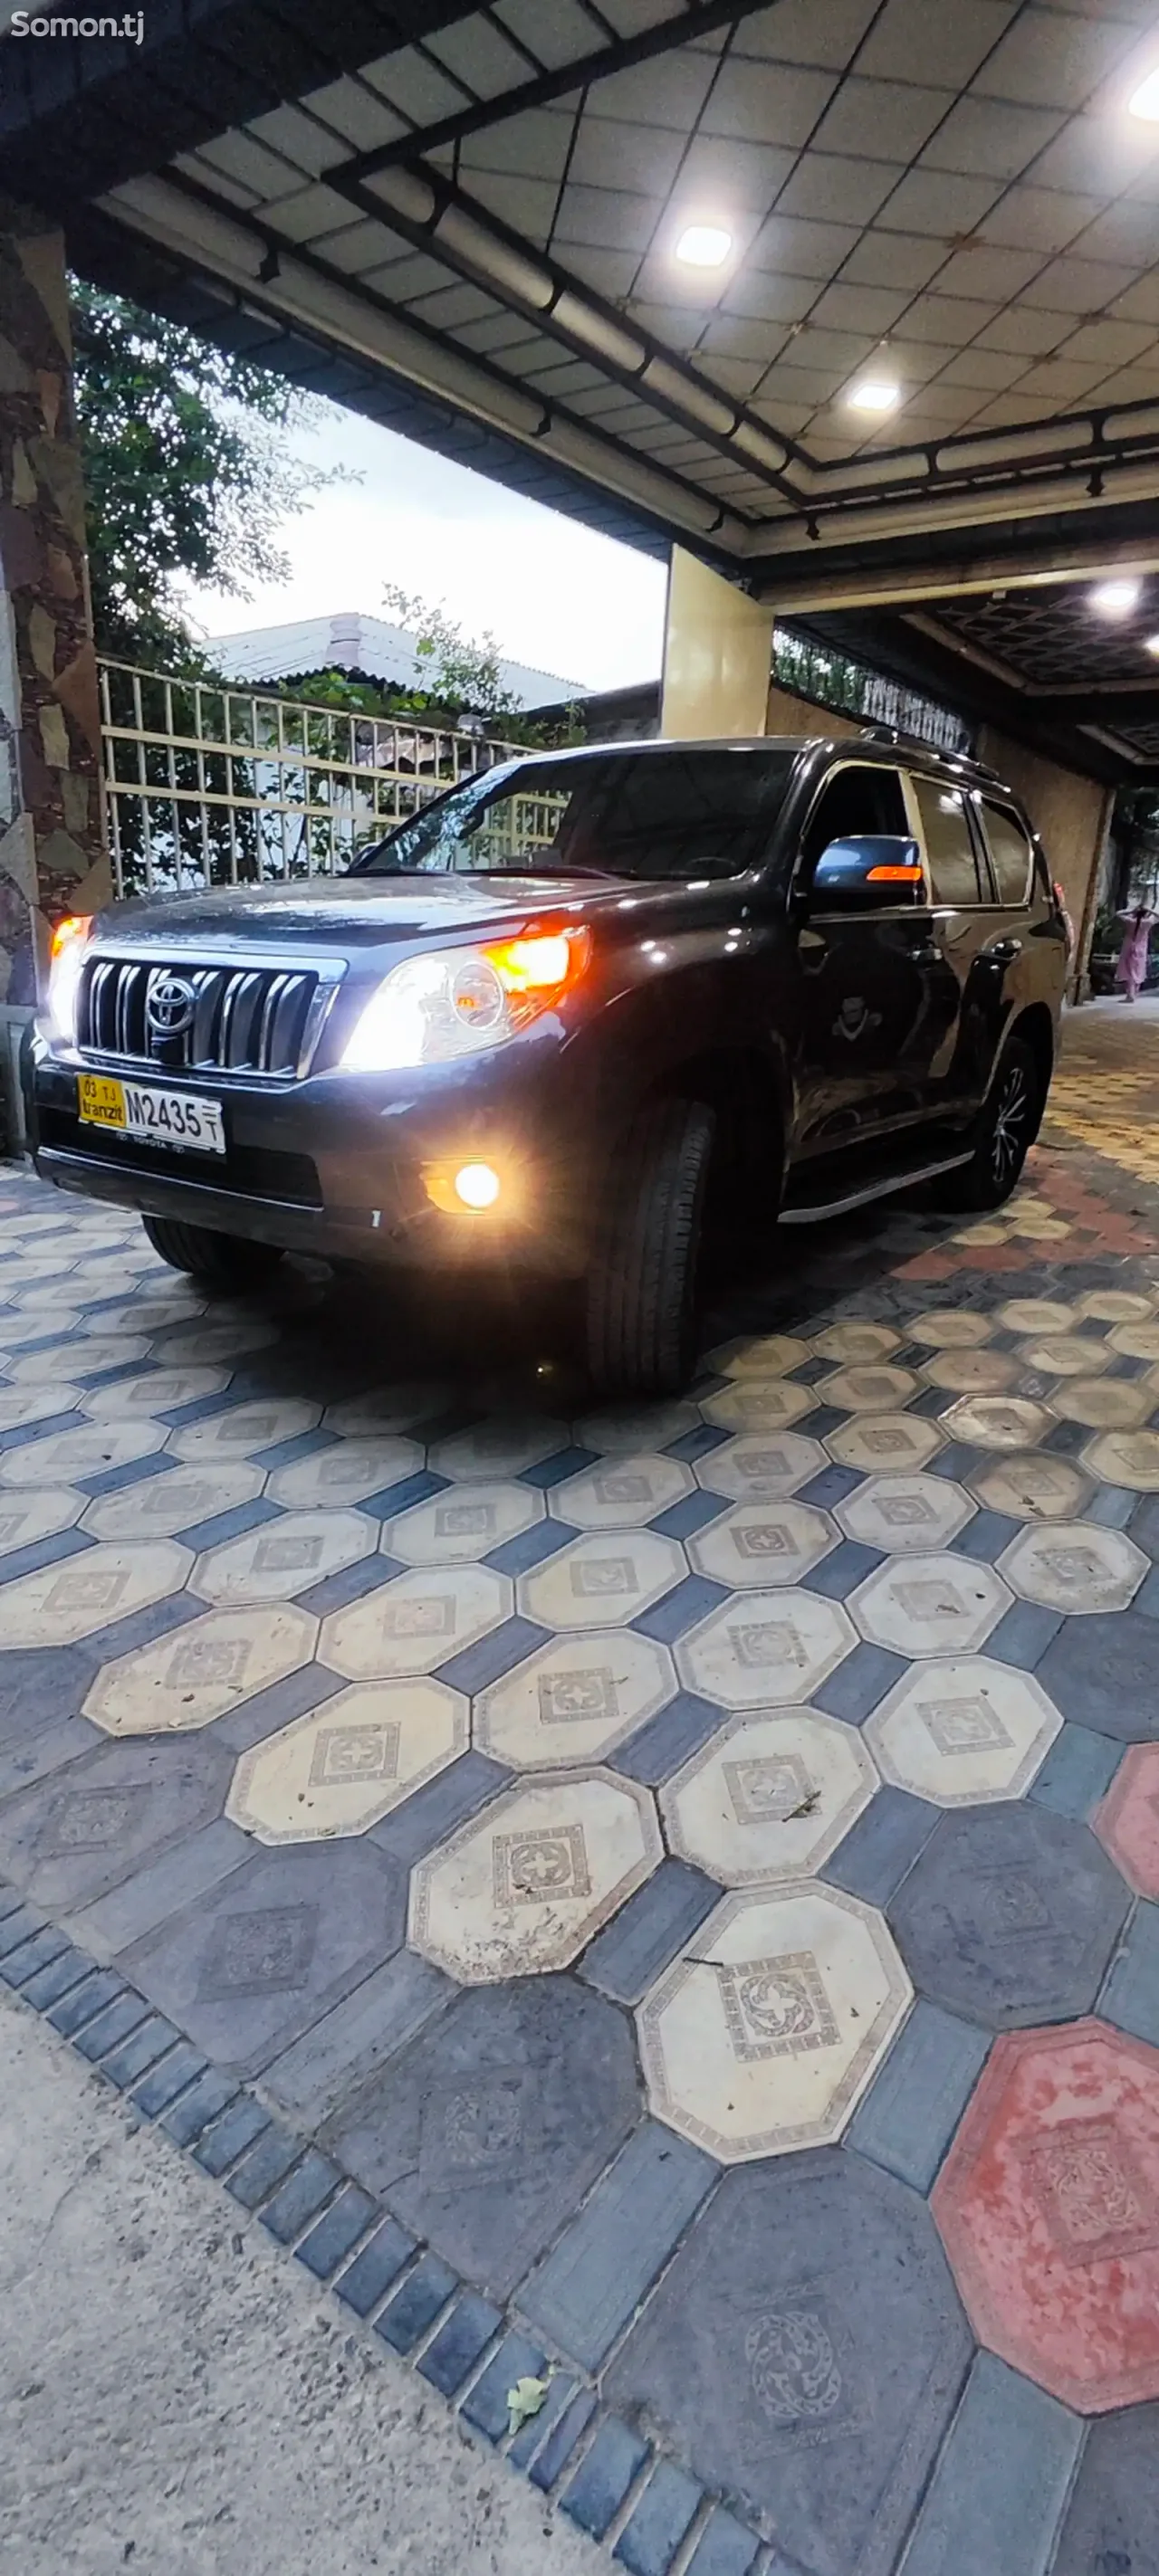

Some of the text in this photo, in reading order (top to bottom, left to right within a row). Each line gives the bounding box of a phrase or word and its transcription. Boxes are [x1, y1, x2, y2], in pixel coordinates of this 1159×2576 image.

[83, 1079, 117, 1102] 03 TJ
[82, 1098, 124, 1121] tranzit
[125, 1089, 202, 1137] M2435
